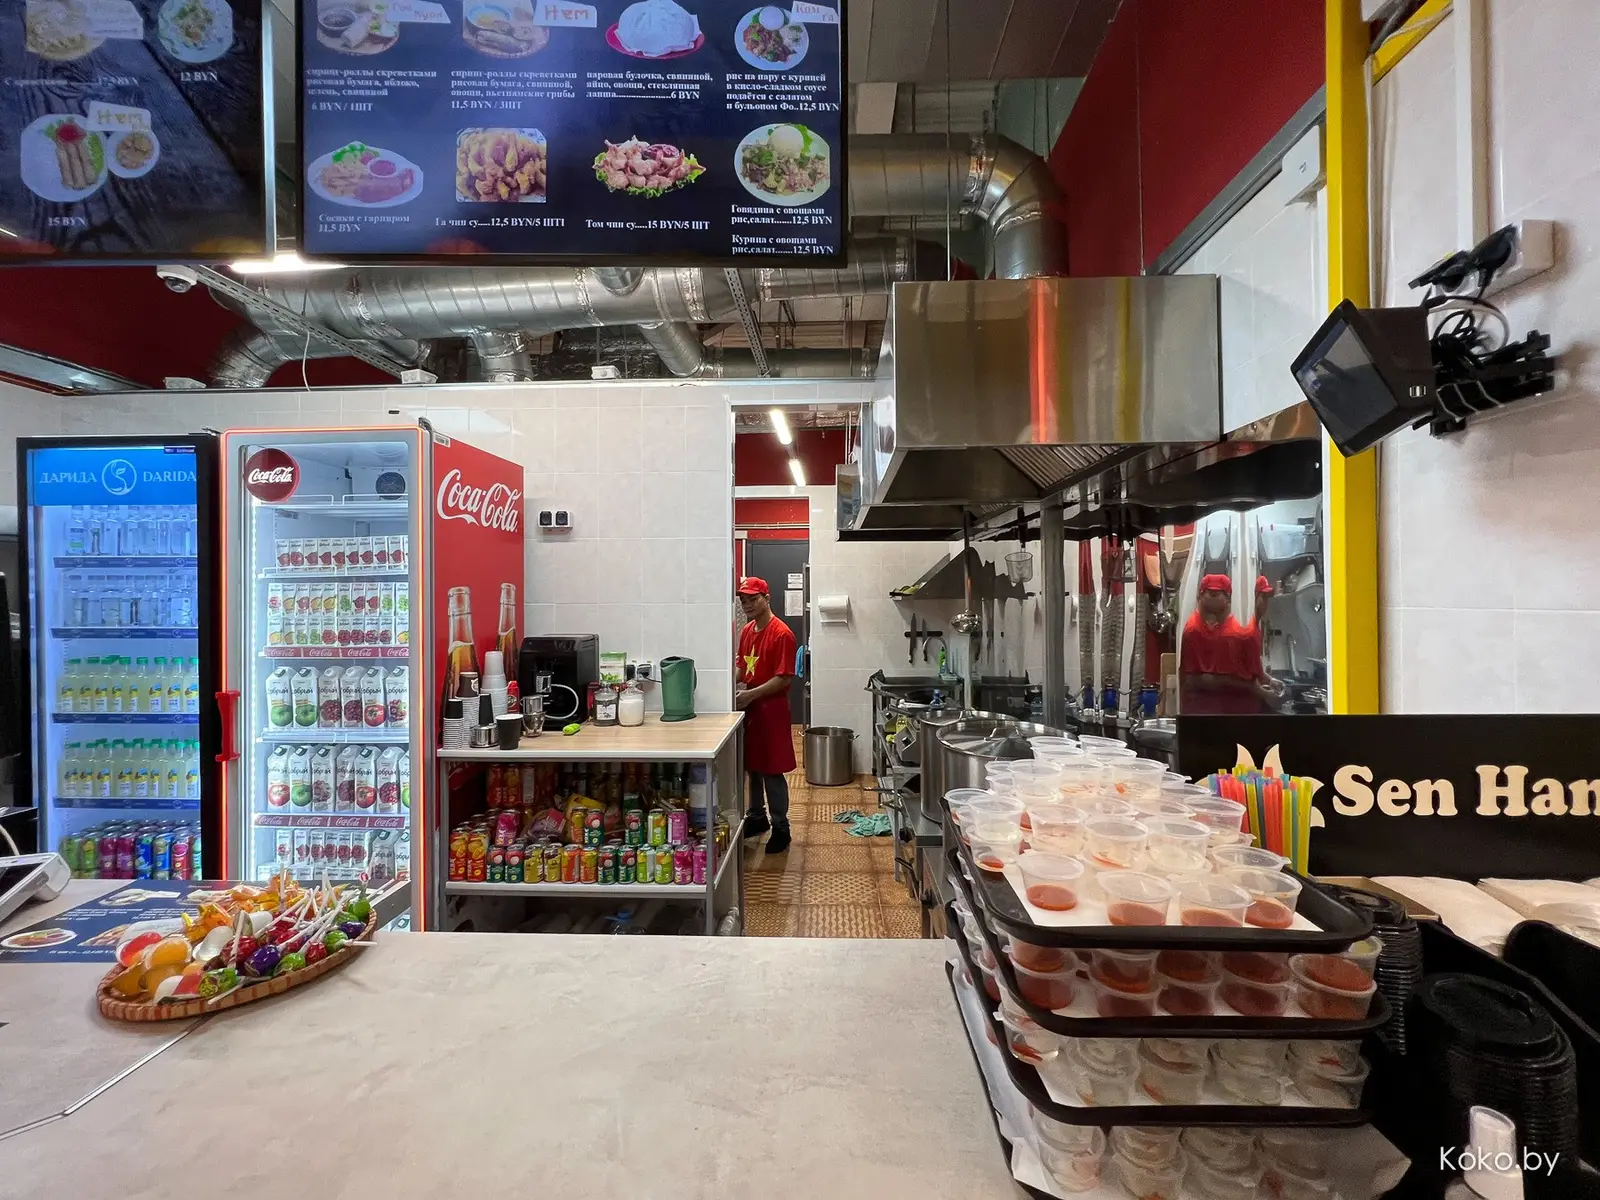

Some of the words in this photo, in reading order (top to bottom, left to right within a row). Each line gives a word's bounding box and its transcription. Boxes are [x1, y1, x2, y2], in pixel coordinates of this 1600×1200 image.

[180, 72, 191, 81] 12
[194, 72, 218, 81] BYN
[586, 72, 624, 80] паровая
[626, 71, 664, 80] булочка,
[666, 72, 713, 82] свининой,
[726, 73, 742, 82] рис
[758, 74, 779, 82] пару
[788, 74, 826, 82] курицей
[451, 80, 488, 88] рисовая
[490, 79, 525, 89] бумага,
[526, 80, 573, 90] свининой,
[586, 82, 612, 90] яйцо,
[614, 82, 646, 90] овощи,
[648, 82, 700, 90] стеклянная
[546, 90, 576, 99] грибы
[678, 91, 700, 100] BYN
[726, 92, 766, 100] подаётся
[312, 102, 318, 110] 6
[320, 102, 342, 110] BYN
[470, 100, 492, 109] BYN
[734, 102, 778, 111] бульоном
[818, 103, 839, 111] BYN
[731, 204, 774, 214] Говядина
[48, 216, 60, 226] 15
[62, 216, 88, 228] BYN
[511, 218, 540, 227] BYN/5
[586, 219, 604, 228] Том
[660, 220, 690, 229] BYN/5
[692, 220, 710, 230] ШТ
[812, 216, 832, 224] BYN
[339, 224, 361, 232] BYN
[732, 234, 767, 244] Курица
[812, 246, 834, 254] BYN
[40, 472, 98, 484] ДАРИДА
[143, 470, 196, 482] DARIDA
[437, 469, 522, 532] Coca-Cola
[1333, 764, 1458, 816] Sen
